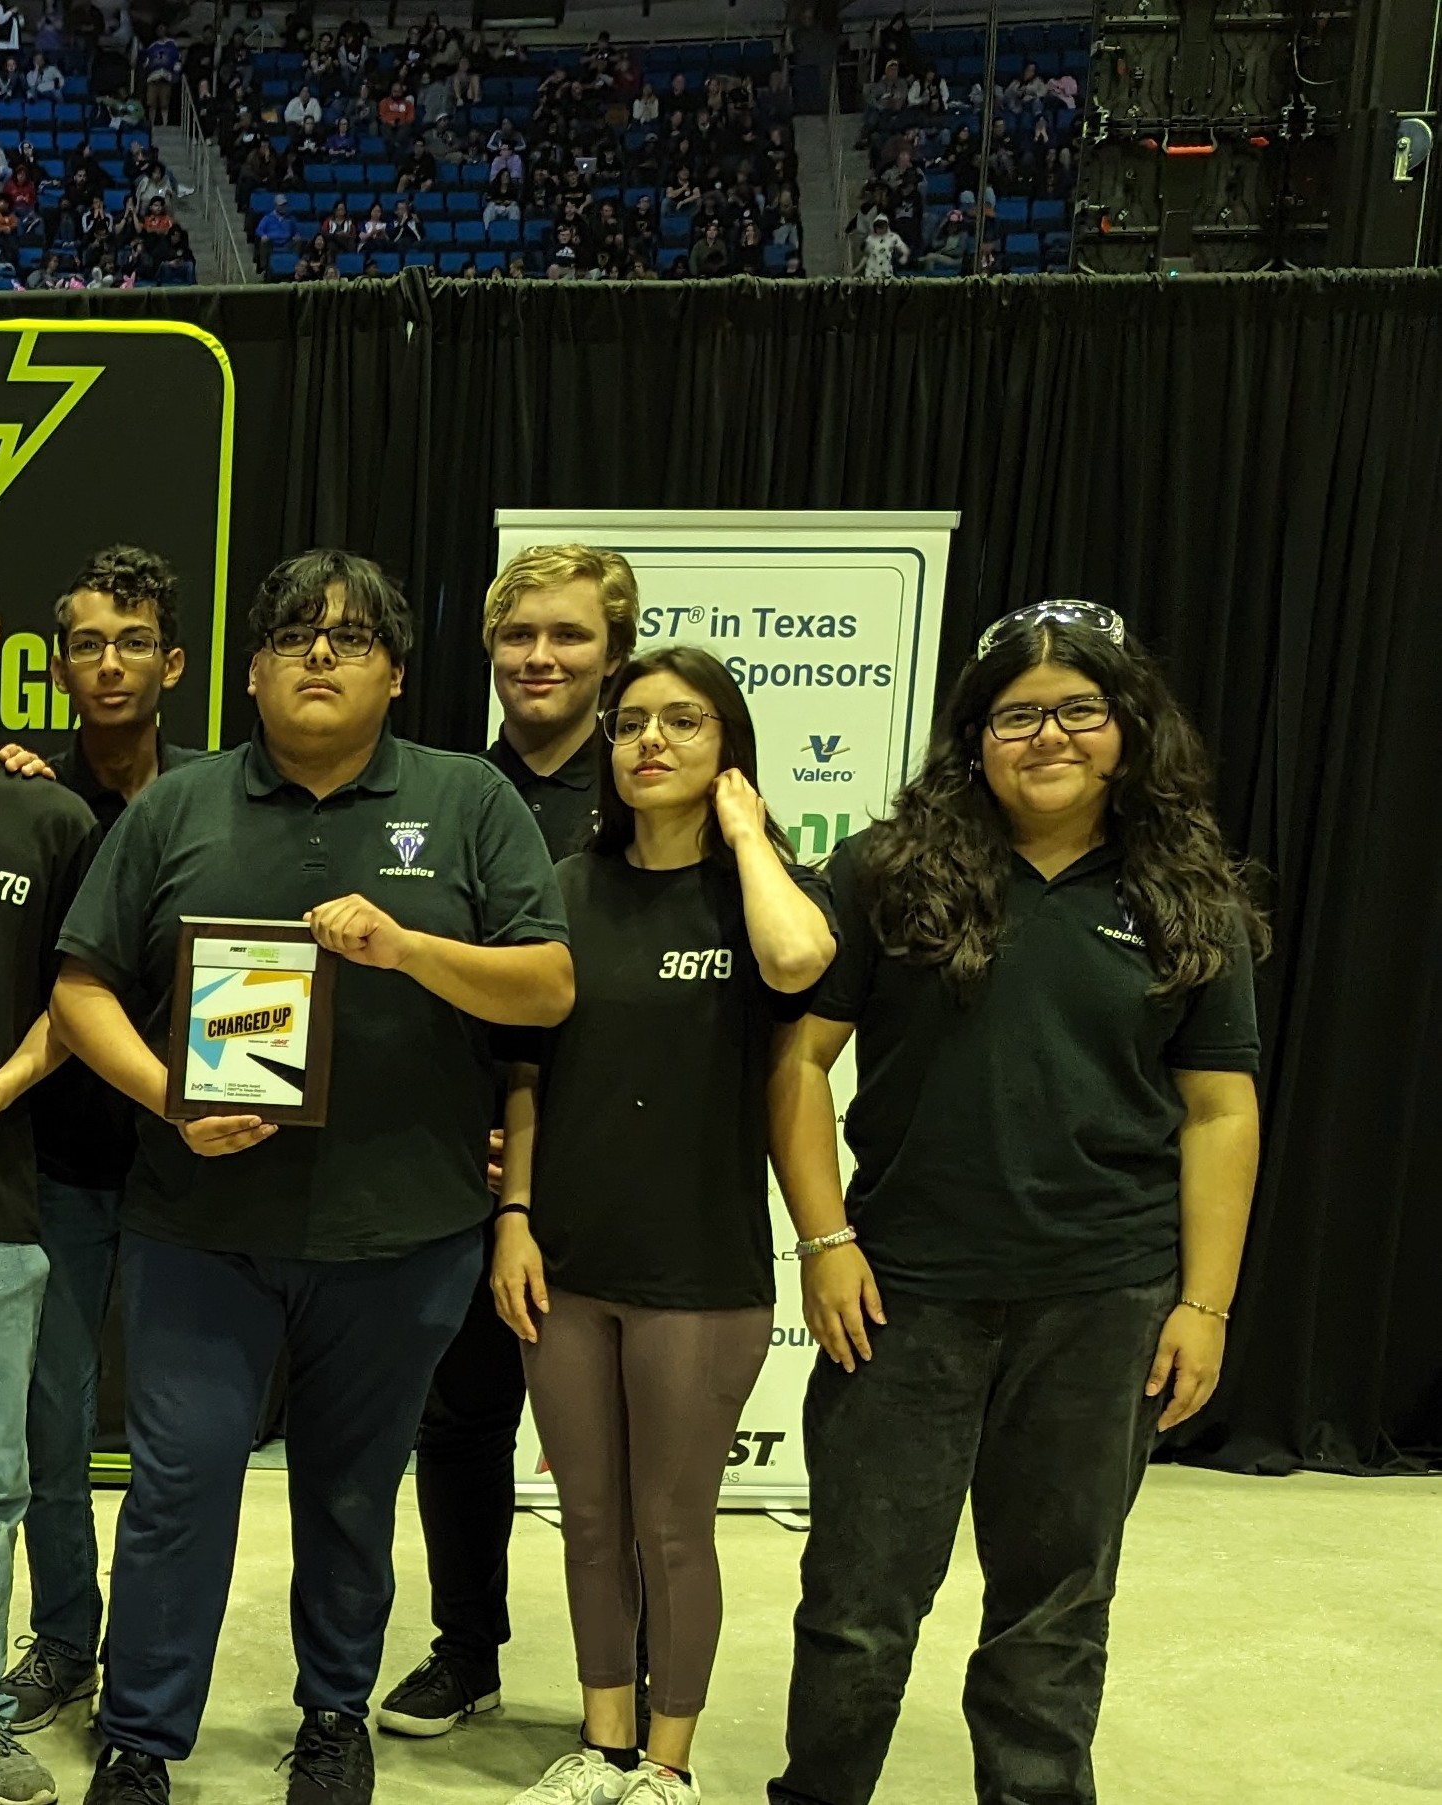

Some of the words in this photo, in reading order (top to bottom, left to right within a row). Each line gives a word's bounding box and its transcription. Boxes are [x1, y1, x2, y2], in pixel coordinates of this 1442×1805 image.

[710, 607, 741, 638] in
[752, 607, 858, 638] Texas
[725, 656, 893, 695] Sponsors
[792, 768, 853, 782] Valero
[385, 821, 429, 829] rattler
[379, 867, 435, 878] robotics
[1097, 925, 1146, 947] robotic
[658, 949, 732, 980] 3679
[207, 1010, 271, 1038] CHARGED
[272, 1006, 292, 1027] UP
[723, 1472, 740, 1483] AS
